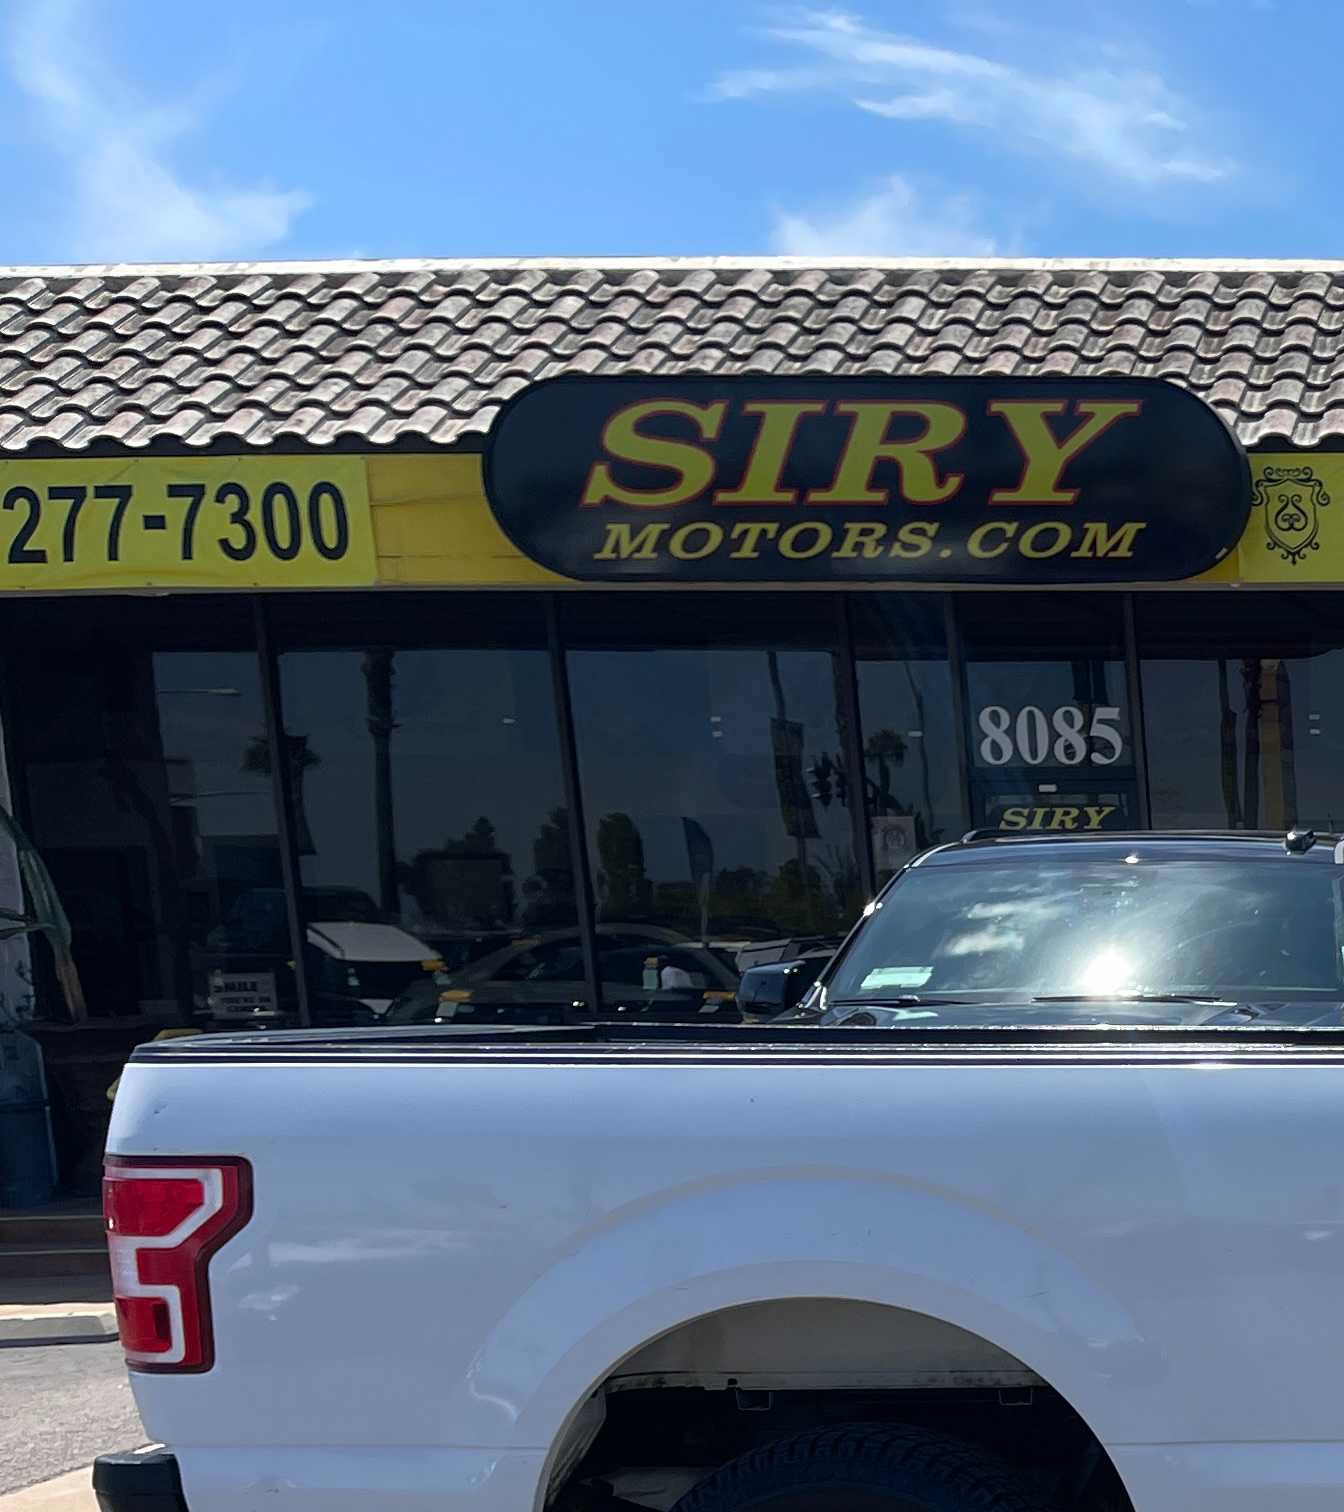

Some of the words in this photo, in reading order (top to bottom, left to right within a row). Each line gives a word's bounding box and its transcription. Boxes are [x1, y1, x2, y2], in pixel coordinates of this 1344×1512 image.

[583, 399, 1144, 508] SIRY
[2, 480, 350, 565] 277-7300
[593, 520, 1147, 562] MOTORS.COM
[978, 705, 1124, 766] 8085
[998, 806, 1117, 830] SIRY
